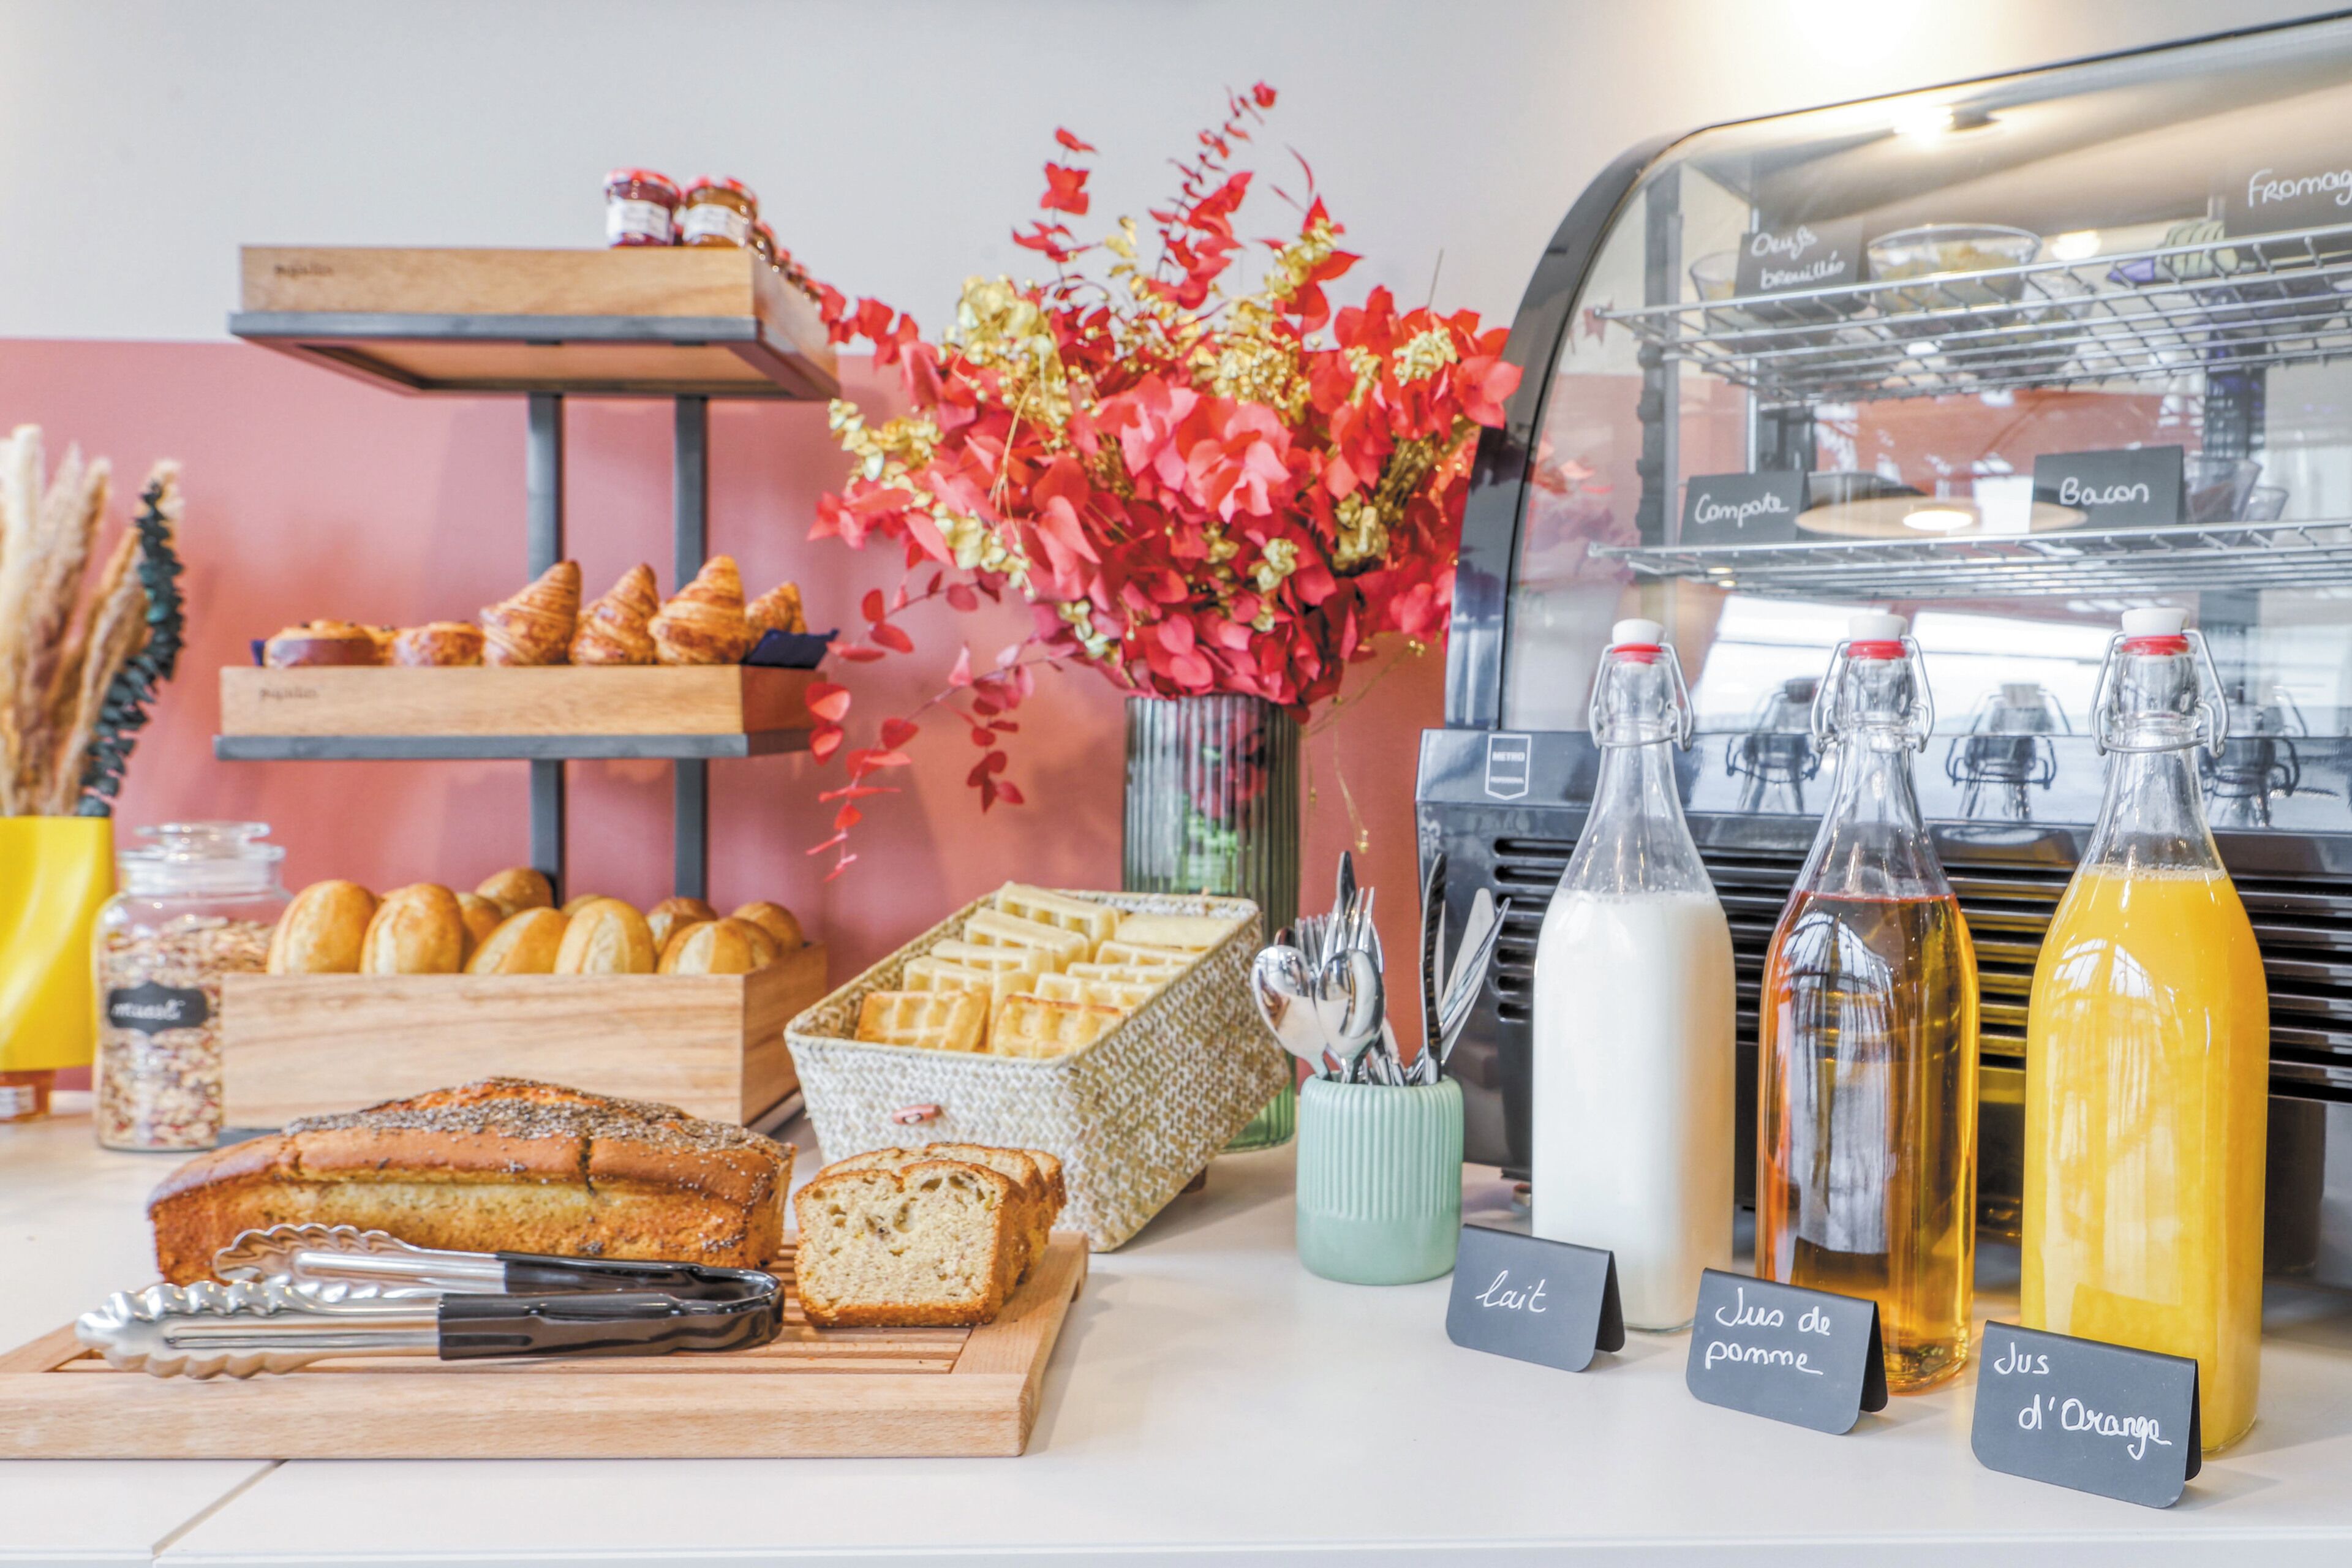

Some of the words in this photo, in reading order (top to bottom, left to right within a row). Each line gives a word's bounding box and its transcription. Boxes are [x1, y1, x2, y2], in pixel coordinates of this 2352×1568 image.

[2059, 476, 2150, 506] Bacon
[1694, 492, 1790, 529] Compote
[1715, 1287, 1784, 1328] Jus
[1798, 1305, 1831, 1336] de
[1705, 1341, 1824, 1376] pomme
[1993, 1341, 2050, 1375] Jus
